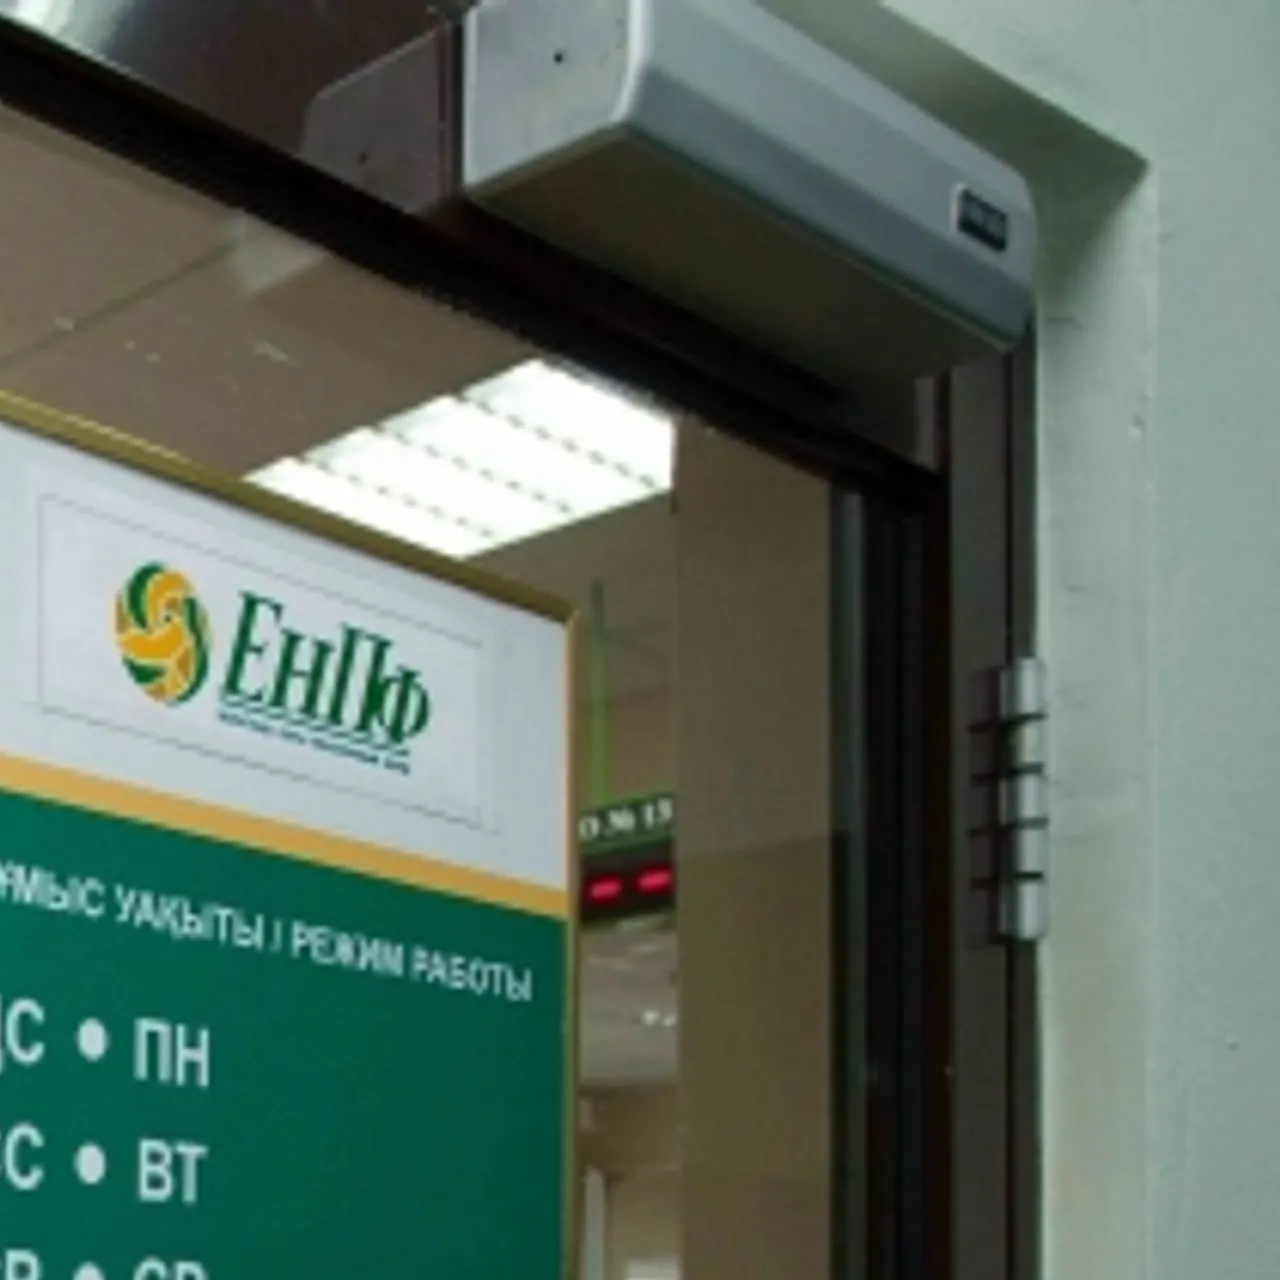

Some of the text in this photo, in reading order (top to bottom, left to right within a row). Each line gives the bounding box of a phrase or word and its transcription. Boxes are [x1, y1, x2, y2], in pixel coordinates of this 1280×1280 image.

[290, 919, 405, 978] РЕЖИМ
[410, 945, 534, 1002] РАБОТЫ
[132, 1017, 211, 1088] ПН
[136, 1138, 209, 1205] ВТ
